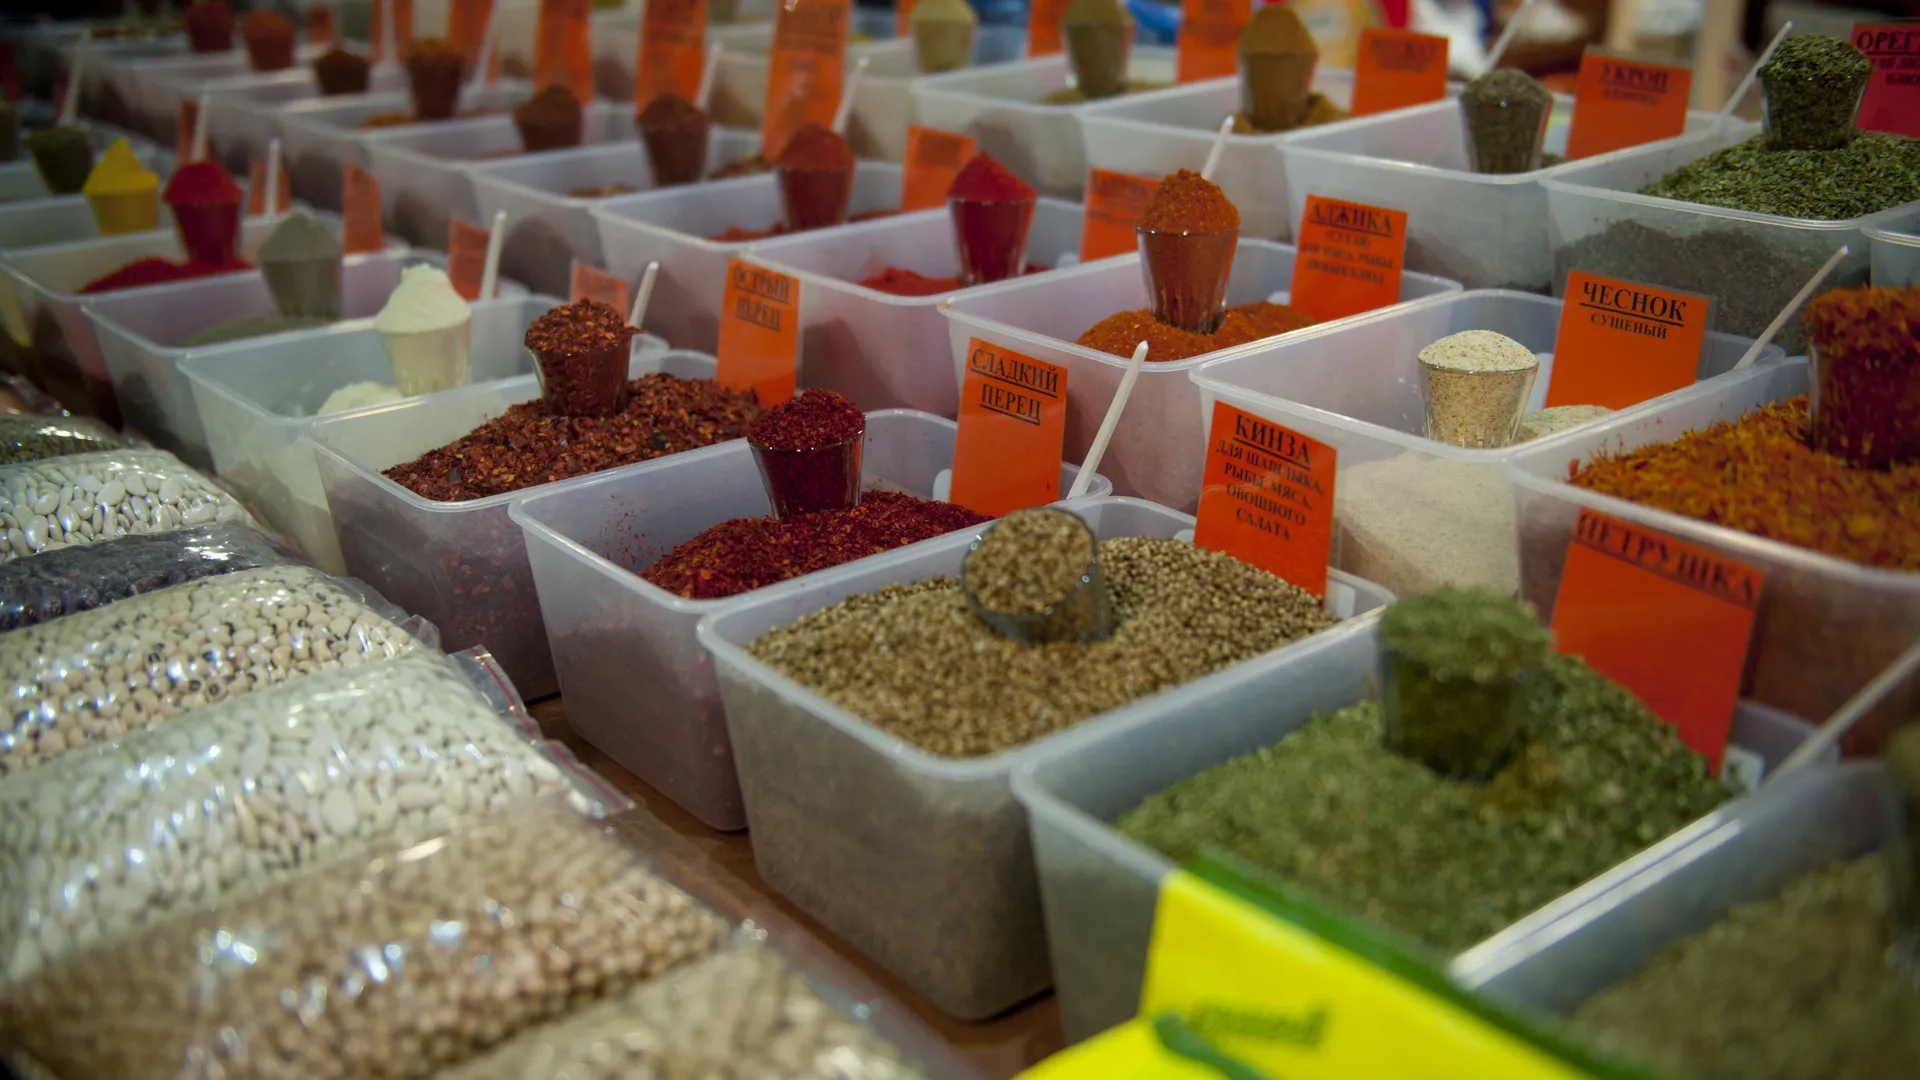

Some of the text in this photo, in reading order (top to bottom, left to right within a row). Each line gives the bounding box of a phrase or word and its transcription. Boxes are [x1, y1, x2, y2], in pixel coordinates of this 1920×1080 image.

[1857, 31, 1920, 51] ОРЕГ
[1600, 62, 1668, 92] УКРОП
[1309, 203, 1392, 235] АДЖИКА
[734, 265, 790, 302] ОСТРЫЙ
[1583, 281, 1687, 321] ЧЕСНОК
[736, 296, 781, 331] ПЕРЕЦ
[1590, 312, 1668, 339] СУШЕНЫЙ
[972, 348, 1059, 393] СЛАДКИЙ
[981, 383, 1042, 424] ПЕРЕЦ
[1215, 439, 1243, 460] ДЛЯ
[1235, 414, 1311, 465] КИНЗА
[1226, 483, 1306, 526] ОВОЩНОГО
[1236, 507, 1291, 542] САЛАТА
[1577, 513, 1755, 603] ПЕТРУШКА
